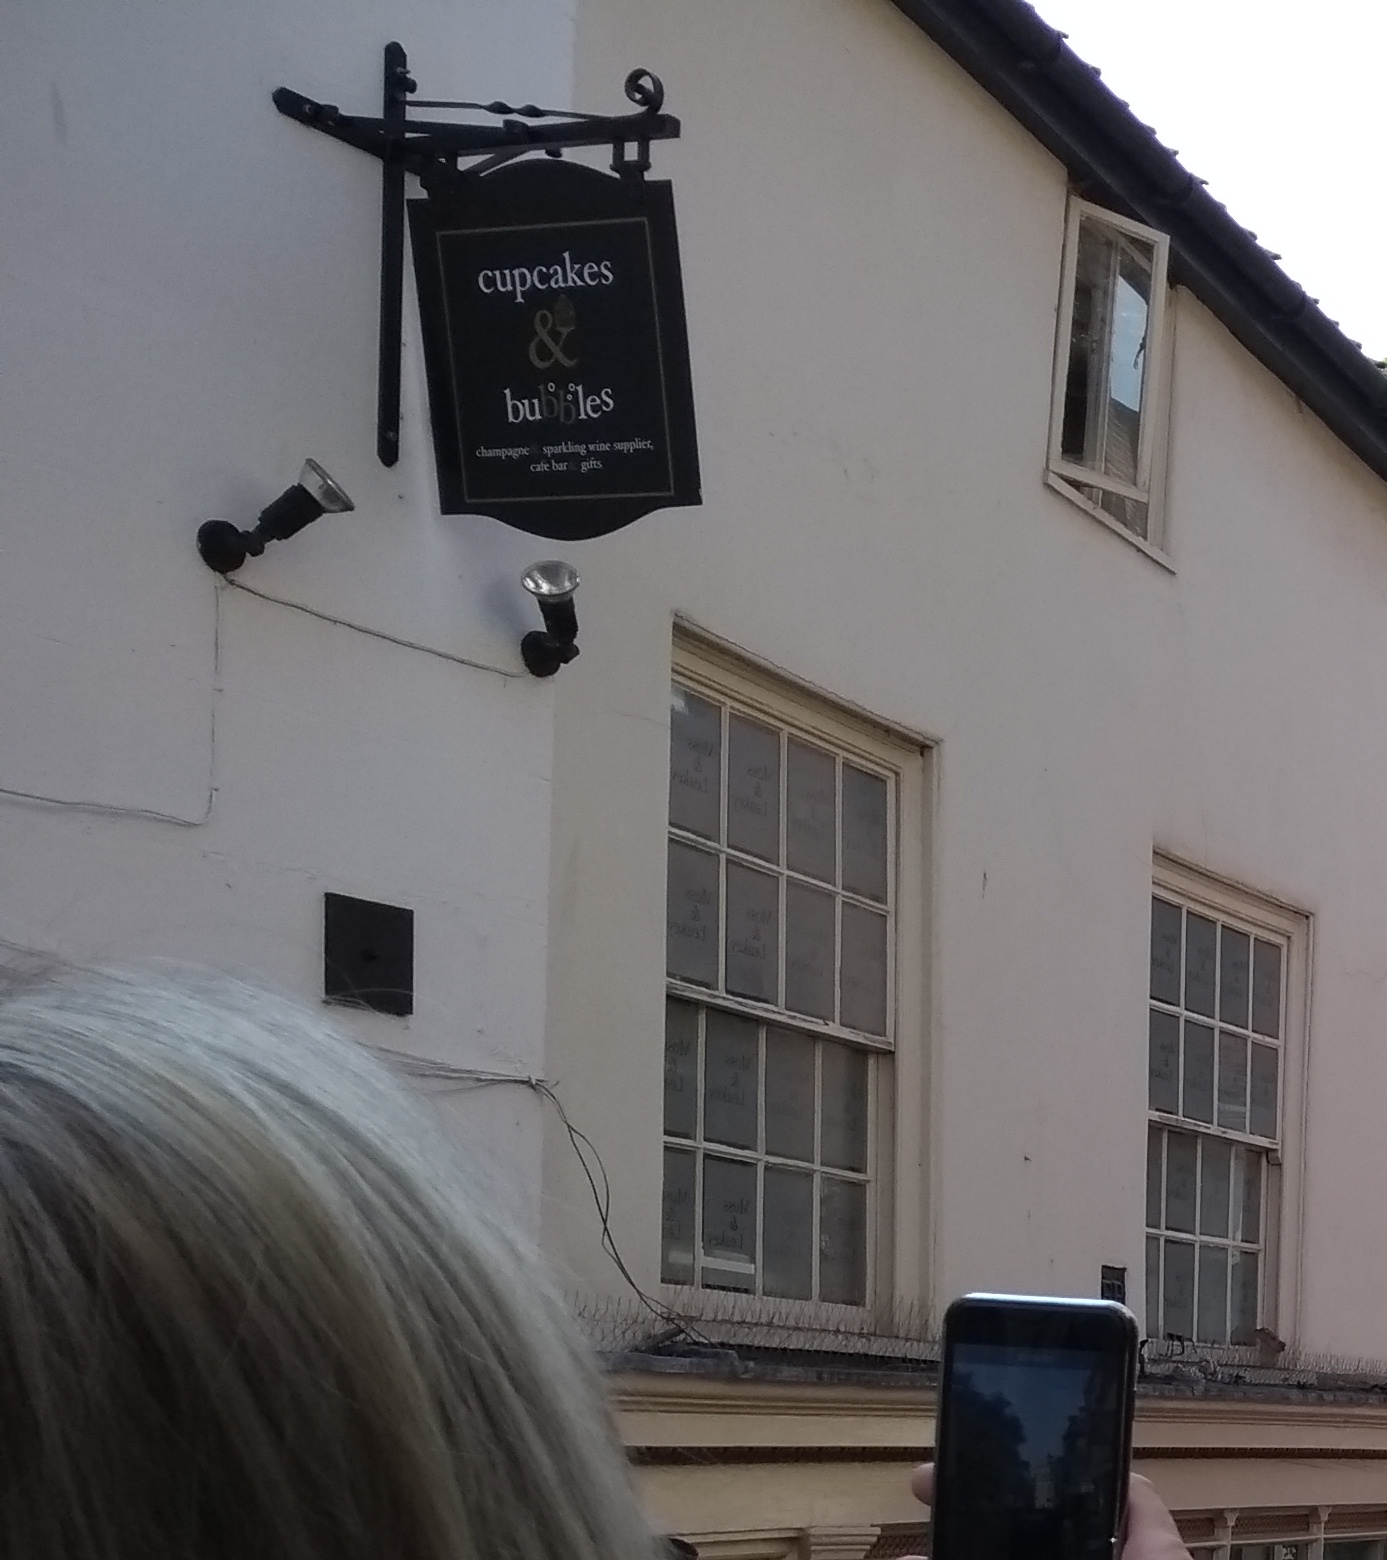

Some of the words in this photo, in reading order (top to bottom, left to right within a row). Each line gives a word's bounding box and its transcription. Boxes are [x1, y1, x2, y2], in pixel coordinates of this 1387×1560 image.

[477, 251, 615, 303] cupcakes
[528, 309, 578, 369] &
[475, 444, 531, 460] champagne
[541, 441, 587, 457] sparkling
[587, 440, 611, 452] wine
[552, 459, 568, 471] bar
[580, 457, 603, 473] gifts
